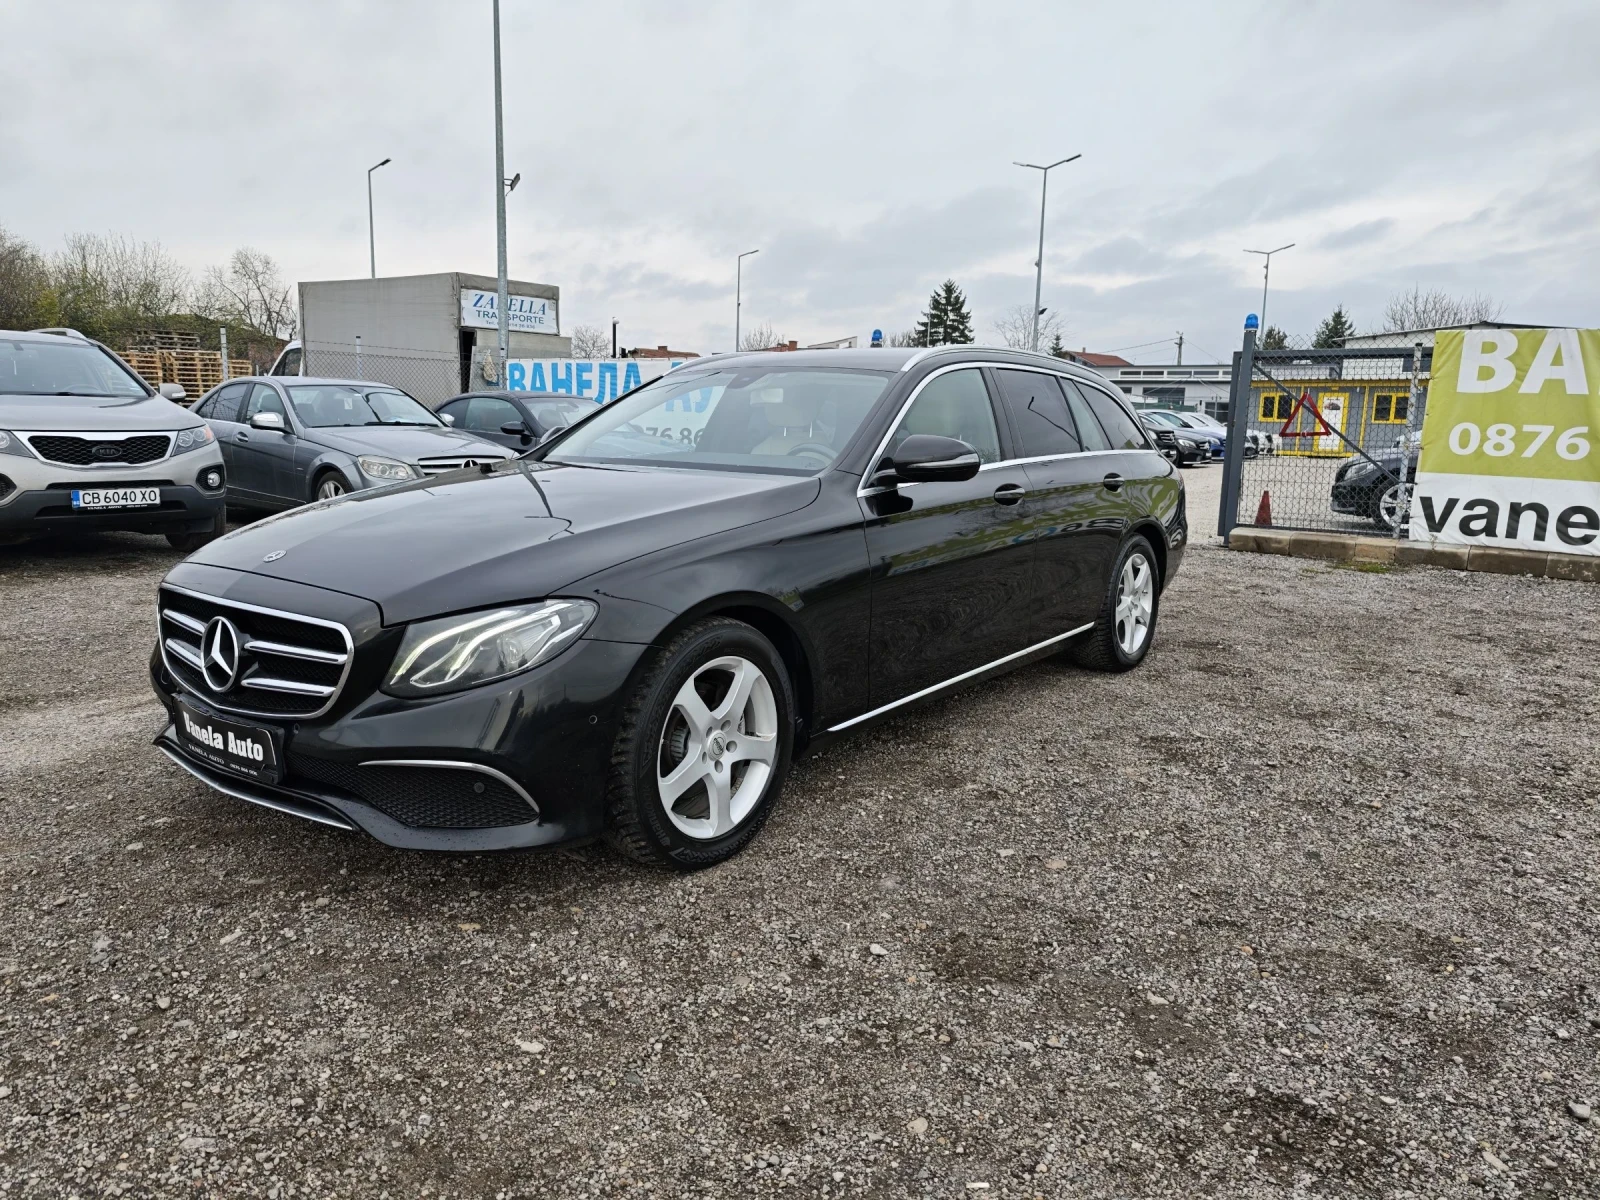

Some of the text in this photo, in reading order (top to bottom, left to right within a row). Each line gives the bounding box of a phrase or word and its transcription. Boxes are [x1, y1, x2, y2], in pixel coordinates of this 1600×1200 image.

[473, 294, 546, 316] ZAELLA
[476, 309, 544, 325] TRASPORTE
[1448, 422, 1591, 461] 0876
[103, 490, 137, 504] 6040
[1419, 496, 1600, 546] vane
[183, 711, 264, 761] Vanela Auto
